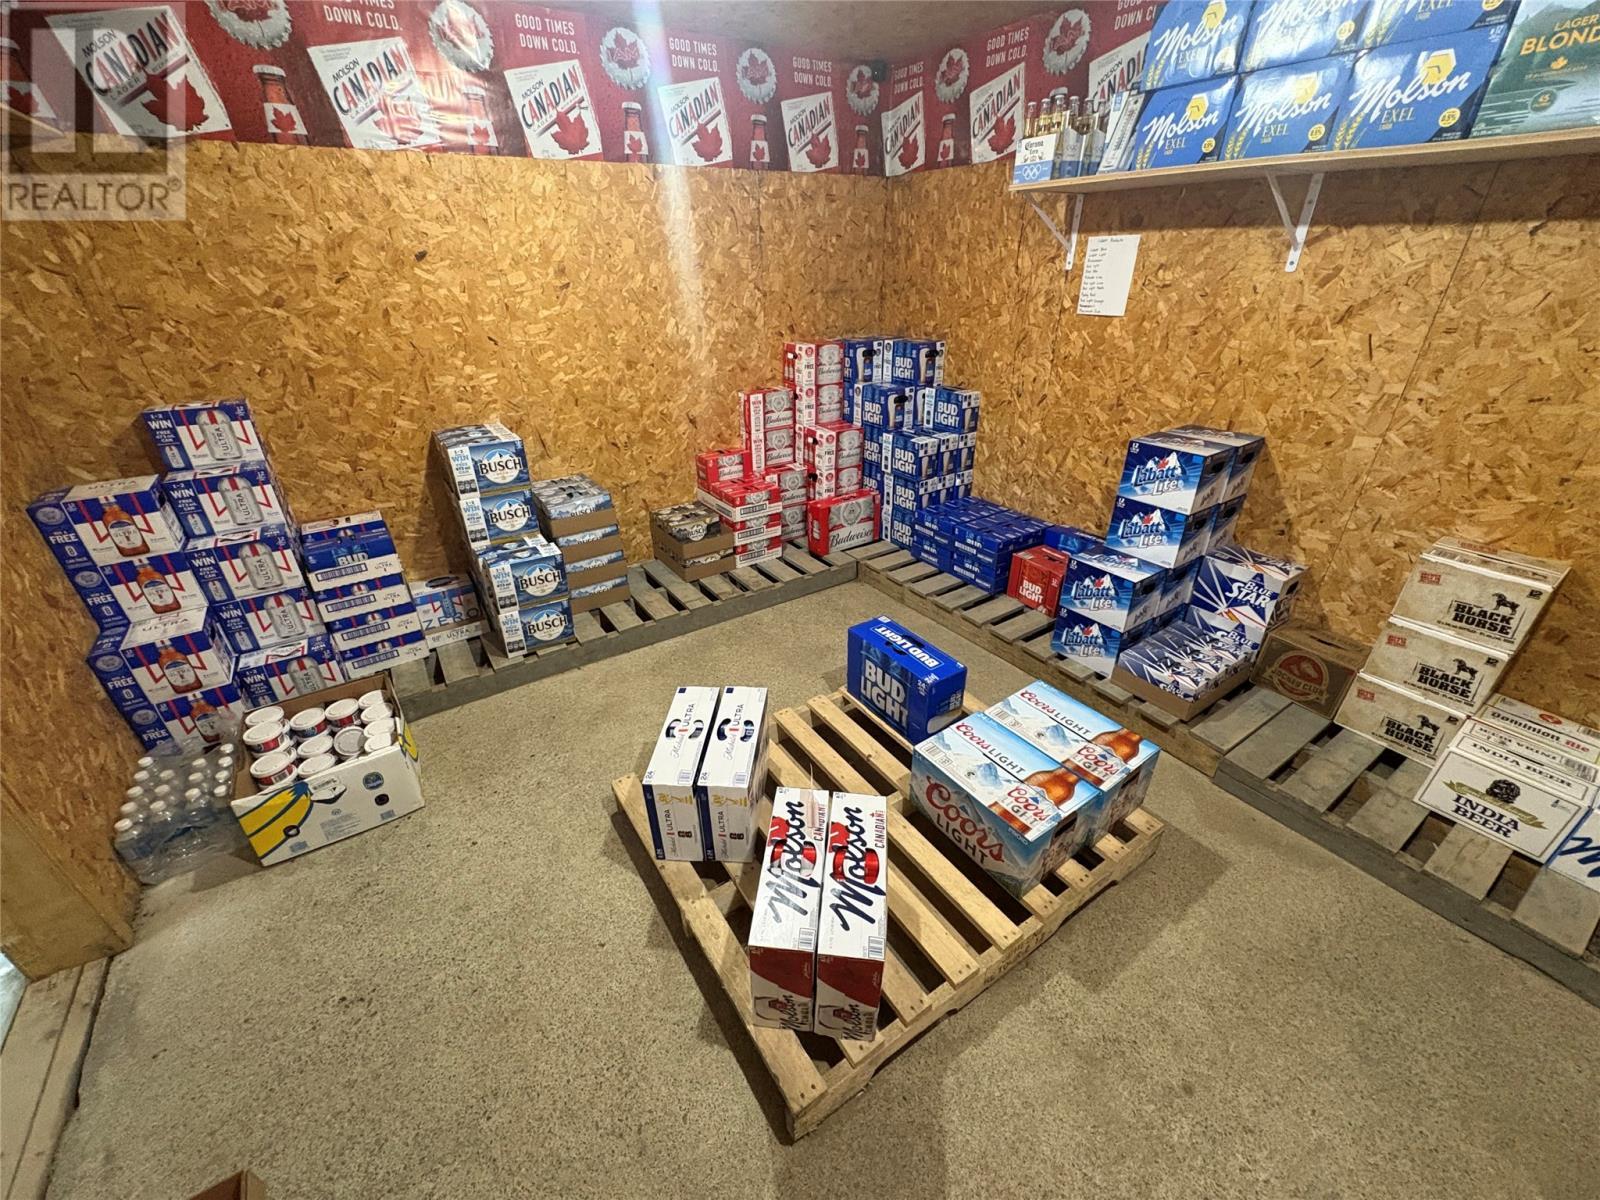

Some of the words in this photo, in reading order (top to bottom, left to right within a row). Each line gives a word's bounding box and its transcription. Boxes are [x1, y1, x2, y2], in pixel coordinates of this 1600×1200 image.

[323, 5, 362, 25] DOWN
[366, 12, 403, 31] COLD.
[515, 13, 542, 32] GOOD
[544, 19, 575, 36] TIMES
[1114, 8, 1142, 30] DOWN
[1553, 13, 1599, 31] LAGER
[82, 29, 118, 58] MOLSON
[519, 33, 549, 51] DOWN
[550, 38, 580, 55] COLD.
[669, 37, 691, 52] GOOD
[692, 41, 717, 56] TIMES
[986, 34, 1005, 52] GOOD
[1007, 26, 1030, 46] TIMES
[1154, 15, 1237, 60] Molson
[85, 12, 180, 96] CANADIAN
[671, 54, 696, 68] DOWN
[792, 56, 811, 70] GOOD
[812, 59, 832, 72] TIMES
[985, 50, 1006, 68] DOWN
[332, 57, 360, 83] MOLSON
[794, 72, 813, 84] DOWN
[909, 61, 924, 74] TIMES
[1097, 58, 1123, 87] MOLSON
[333, 45, 408, 115] CANADIAN
[521, 79, 544, 100] MOLSON
[520, 69, 580, 130] CANADIAN
[972, 70, 1020, 138] CANADIAN
[1349, 71, 1472, 124] Molson
[669, 80, 720, 138] CANADIAN
[1235, 92, 1332, 137] Molson
[1380, 106, 1416, 124] EXEL
[788, 97, 830, 148] CANADIAN
[885, 96, 920, 154] CANADIAN
[1143, 107, 1218, 149] Molson
[1262, 123, 1289, 138] EXEL
[1164, 136, 1186, 151] EXEL
[893, 367, 914, 379] LIGHT
[895, 357, 912, 368] BUD
[864, 401, 881, 413] BUD
[937, 401, 958, 415] BUD
[148, 419, 173, 430] WIN
[863, 412, 883, 425] LIGHT
[934, 412, 960, 427] LIGHT
[214, 427, 230, 453] ULTRA
[479, 457, 522, 475] BUSCH
[893, 459, 917, 474] LIGHT
[895, 448, 915, 463] BUD
[1132, 465, 1177, 487] Labatt
[170, 489, 194, 499] WIN
[896, 485, 915, 500] BUD
[1152, 479, 1178, 496] Lite
[236, 493, 251, 517] ULTRA
[894, 495, 916, 511] LIGHT
[489, 507, 531, 524] BUSCH
[49, 533, 78, 544] FREE
[830, 528, 873, 549] Budweiser
[892, 529, 913, 546] LIGHT
[894, 521, 912, 536] BUD
[1119, 519, 1161, 539] Labatt
[1139, 532, 1163, 548] Lite
[191, 557, 215, 567] WIN
[337, 552, 369, 566] BUD
[257, 559, 272, 582] ULTRA
[520, 571, 561, 589] BUSCH
[1019, 586, 1043, 603] LIGHT
[1022, 580, 1042, 594] BUD
[1073, 582, 1110, 600] Labatt
[1225, 582, 1271, 608] STAR
[1244, 581, 1273, 598] BLUE
[1529, 589, 1543, 598] 12
[87, 594, 115, 606] FREE
[1090, 597, 1113, 611] Lite
[220, 609, 242, 619] WIN
[280, 609, 295, 632] ULTRA
[422, 608, 482, 631] ZERO
[527, 616, 567, 634] BUSCH
[1452, 612, 1513, 636] HORSE
[1453, 603, 1514, 625] BLACK
[874, 626, 913, 649] LIGHT
[1063, 628, 1100, 646] Labatt
[1228, 631, 1253, 647] BLUE
[909, 647, 940, 668] BUD
[1080, 643, 1101, 657] Lite
[107, 677, 136, 690] FREE
[243, 674, 266, 684] WIN
[865, 659, 905, 703] BUD
[1417, 675, 1471, 699] HORSE
[1419, 666, 1473, 689] BLACK
[861, 676, 908, 728] LIGHT
[1020, 689, 1055, 715] Coors
[1054, 711, 1092, 736] LIGHT
[682, 703, 695, 726] ULTRA
[732, 703, 744, 726] ULTRA
[142, 728, 168, 740] FREE
[1384, 727, 1434, 752] HORSE
[1386, 720, 1436, 743] BLACK
[955, 722, 989, 750] Coors
[988, 747, 1026, 774] LIGHT
[1072, 755, 1110, 779] LIGHT
[1077, 745, 1120, 776] Coors
[1472, 743, 1520, 766] INDIA
[1525, 765, 1572, 787] BEER
[1001, 799, 1039, 825] LIGHT
[1006, 786, 1051, 821] Coors
[1451, 794, 1520, 832] INDIA
[664, 809, 674, 831] ULTRA
[717, 811, 726, 833] ULTRA
[875, 813, 885, 848] CANADIAN
[925, 776, 1005, 863] Coors
[1451, 803, 1512, 838] BEER
[936, 813, 988, 865] LIGHT
[766, 801, 820, 923] Molson
[829, 806, 886, 931] Molson
